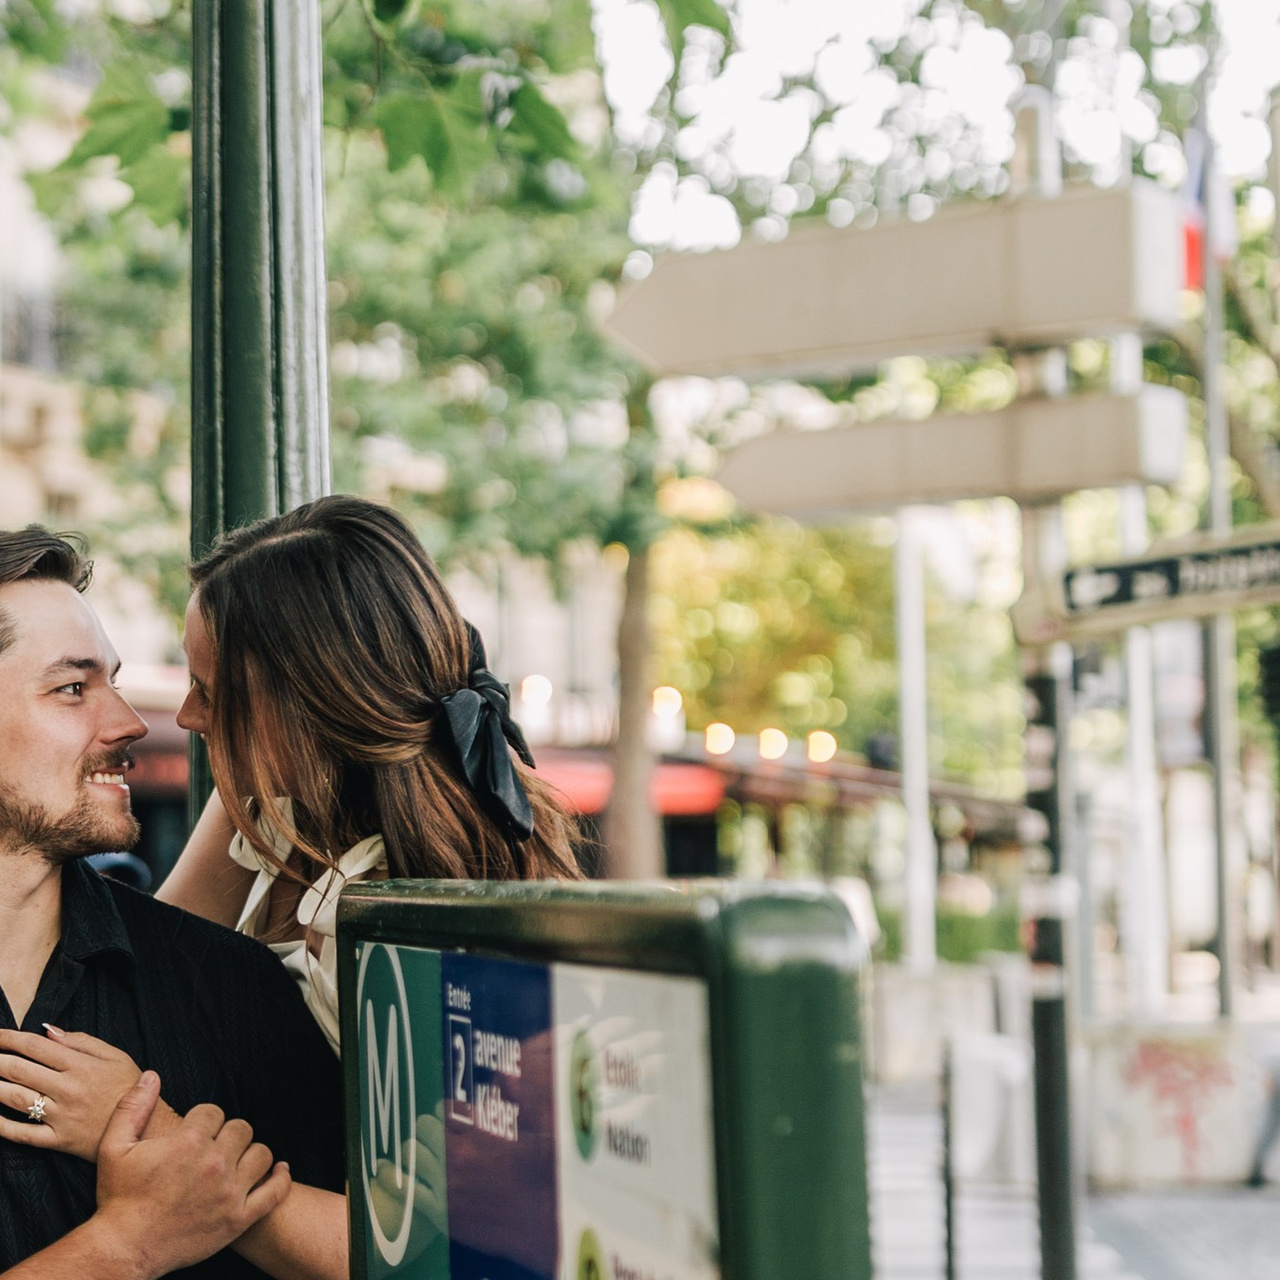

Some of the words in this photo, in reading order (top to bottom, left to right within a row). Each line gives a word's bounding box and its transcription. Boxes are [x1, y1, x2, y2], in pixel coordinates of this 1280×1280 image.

[448, 982, 471, 1011] Entrée
[453, 1032, 468, 1103] 2
[474, 1029, 521, 1078] avenue
[366, 998, 402, 1190] M
[476, 1082, 520, 1142] Kléber
[607, 1119, 651, 1165] Nation
